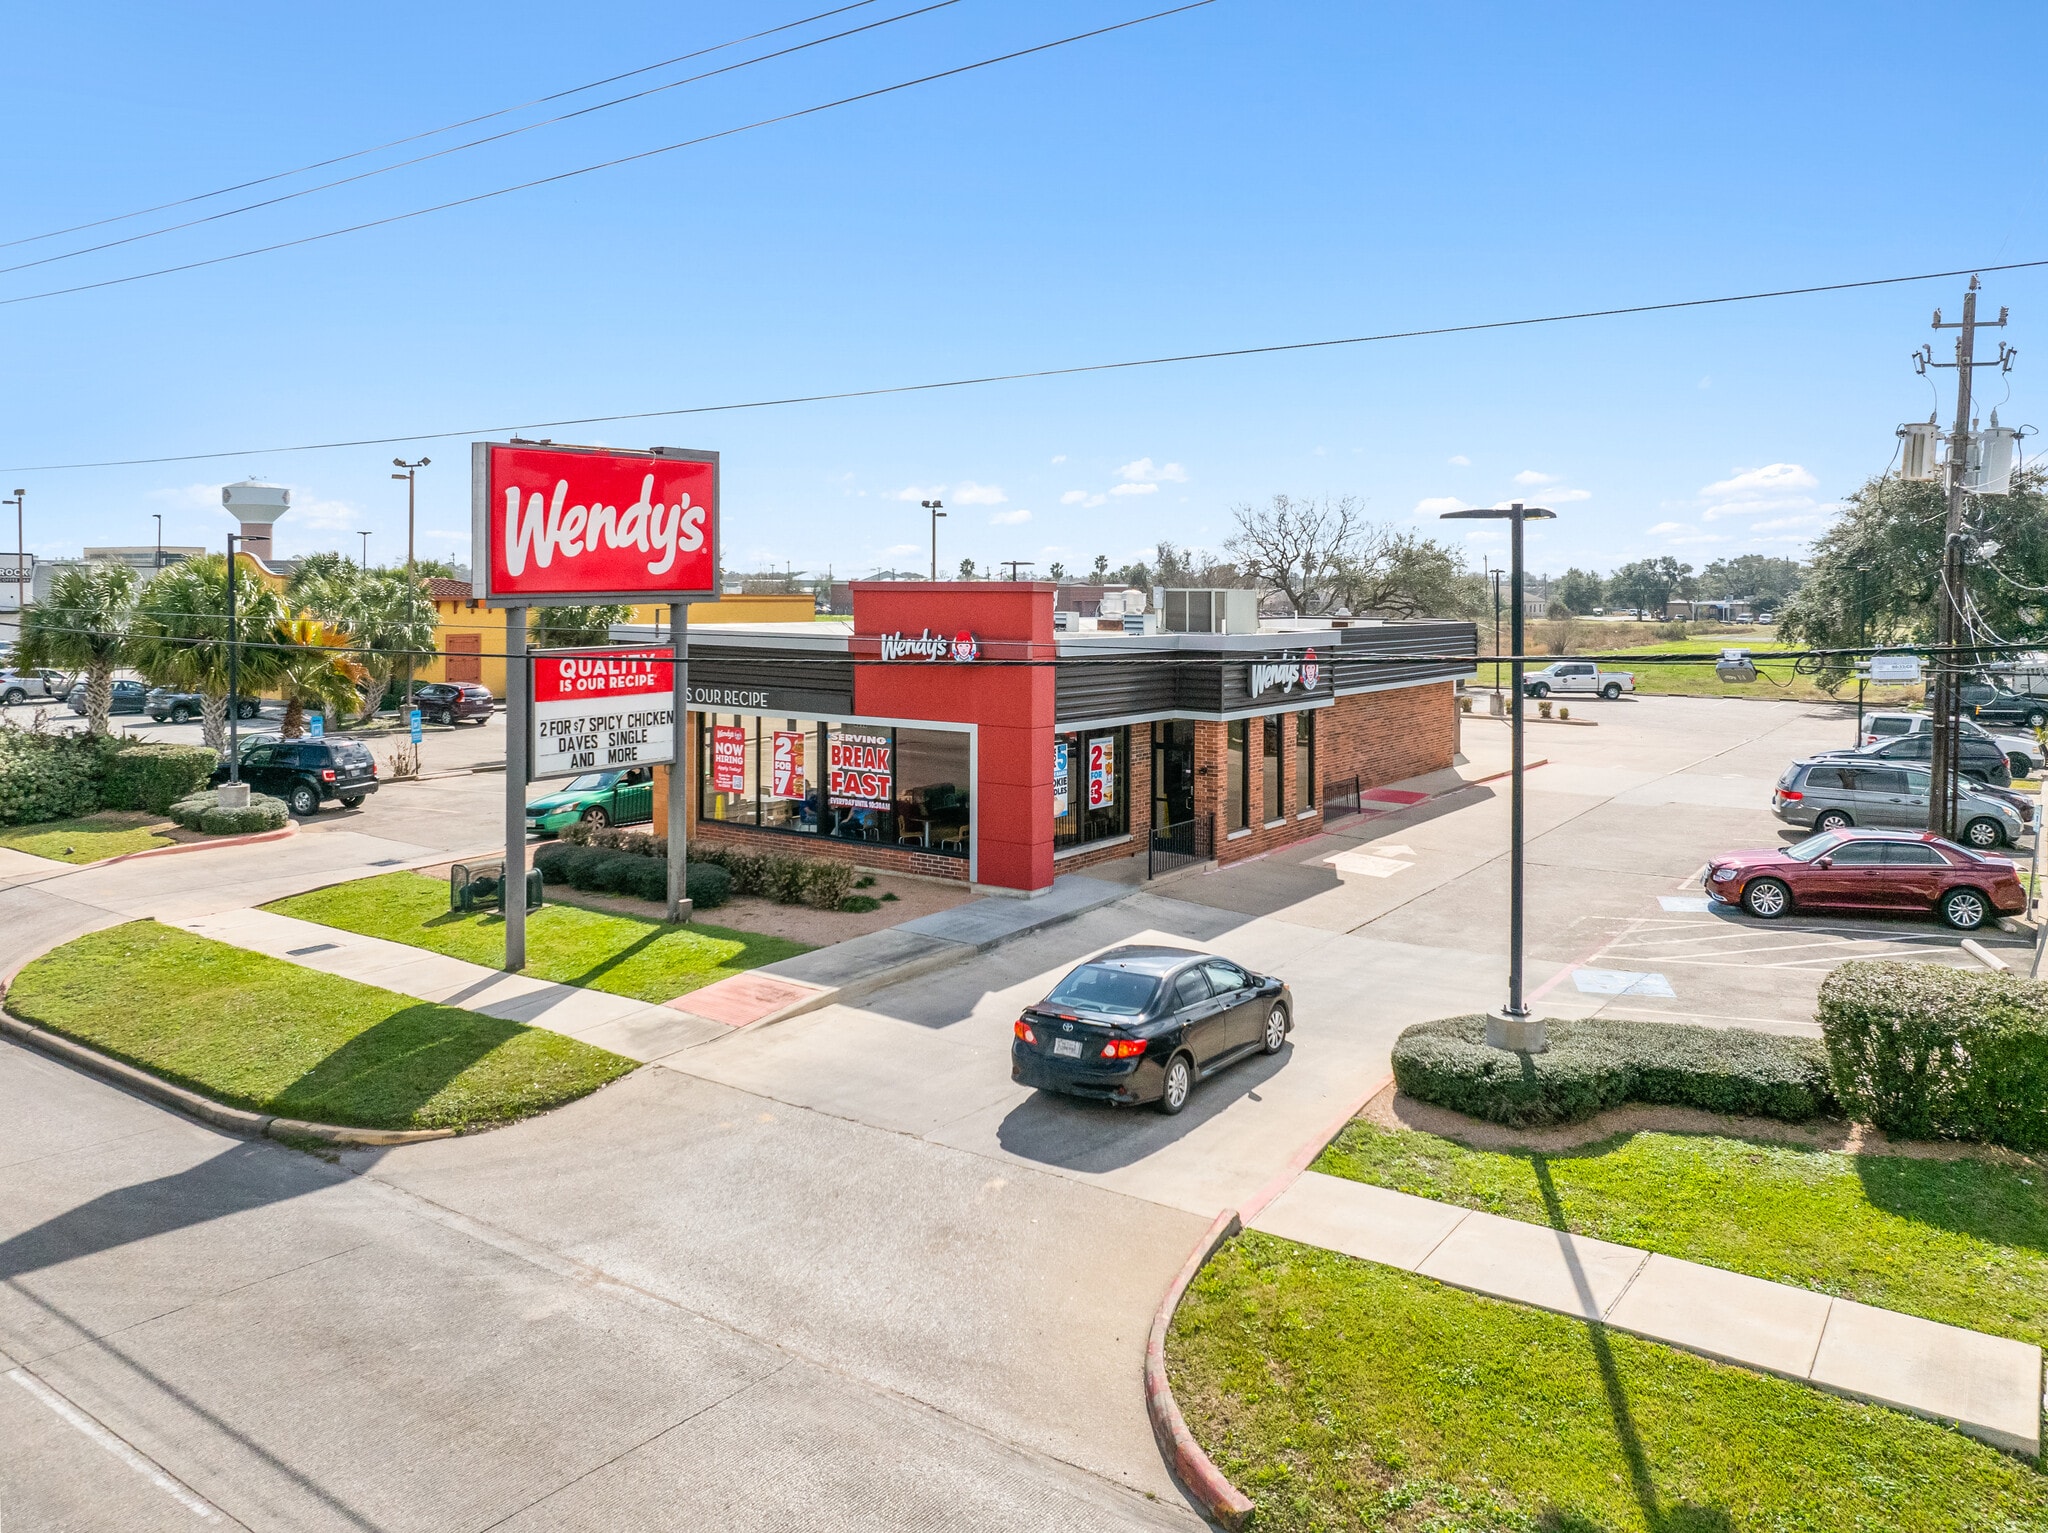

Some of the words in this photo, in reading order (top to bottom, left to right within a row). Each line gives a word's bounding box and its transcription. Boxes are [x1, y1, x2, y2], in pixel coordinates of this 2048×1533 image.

[505, 474, 706, 577] Wendy's
[881, 628, 947, 661] Wendy's
[559, 653, 656, 679] QUALITY
[1252, 649, 1300, 699] Wendy's
[560, 680, 572, 692] IS
[577, 678, 605, 691] OUR
[610, 674, 655, 689] RECIPE
[686, 687, 693, 702] S
[695, 688, 721, 703] OUR
[724, 690, 769, 707] RECIPE
[540, 722, 547, 737] 2
[549, 720, 571, 736] FOR
[574, 719, 585, 734] $7
[589, 714, 622, 732] SPICY
[627, 710, 674, 728] CHICKEN
[559, 734, 598, 753] DAVES
[608, 729, 647, 747] SINGLE
[715, 742, 744, 757] NOW
[775, 736, 791, 762] 2
[831, 734, 887, 745] SERVING
[571, 752, 595, 768] AND
[608, 747, 637, 764] MORE
[715, 754, 744, 765] HIRING
[775, 761, 791, 771] FOR
[831, 745, 890, 773] BREAK
[1091, 745, 1103, 771] 2
[831, 771, 891, 800] FAST
[1091, 771, 1102, 780] FOR
